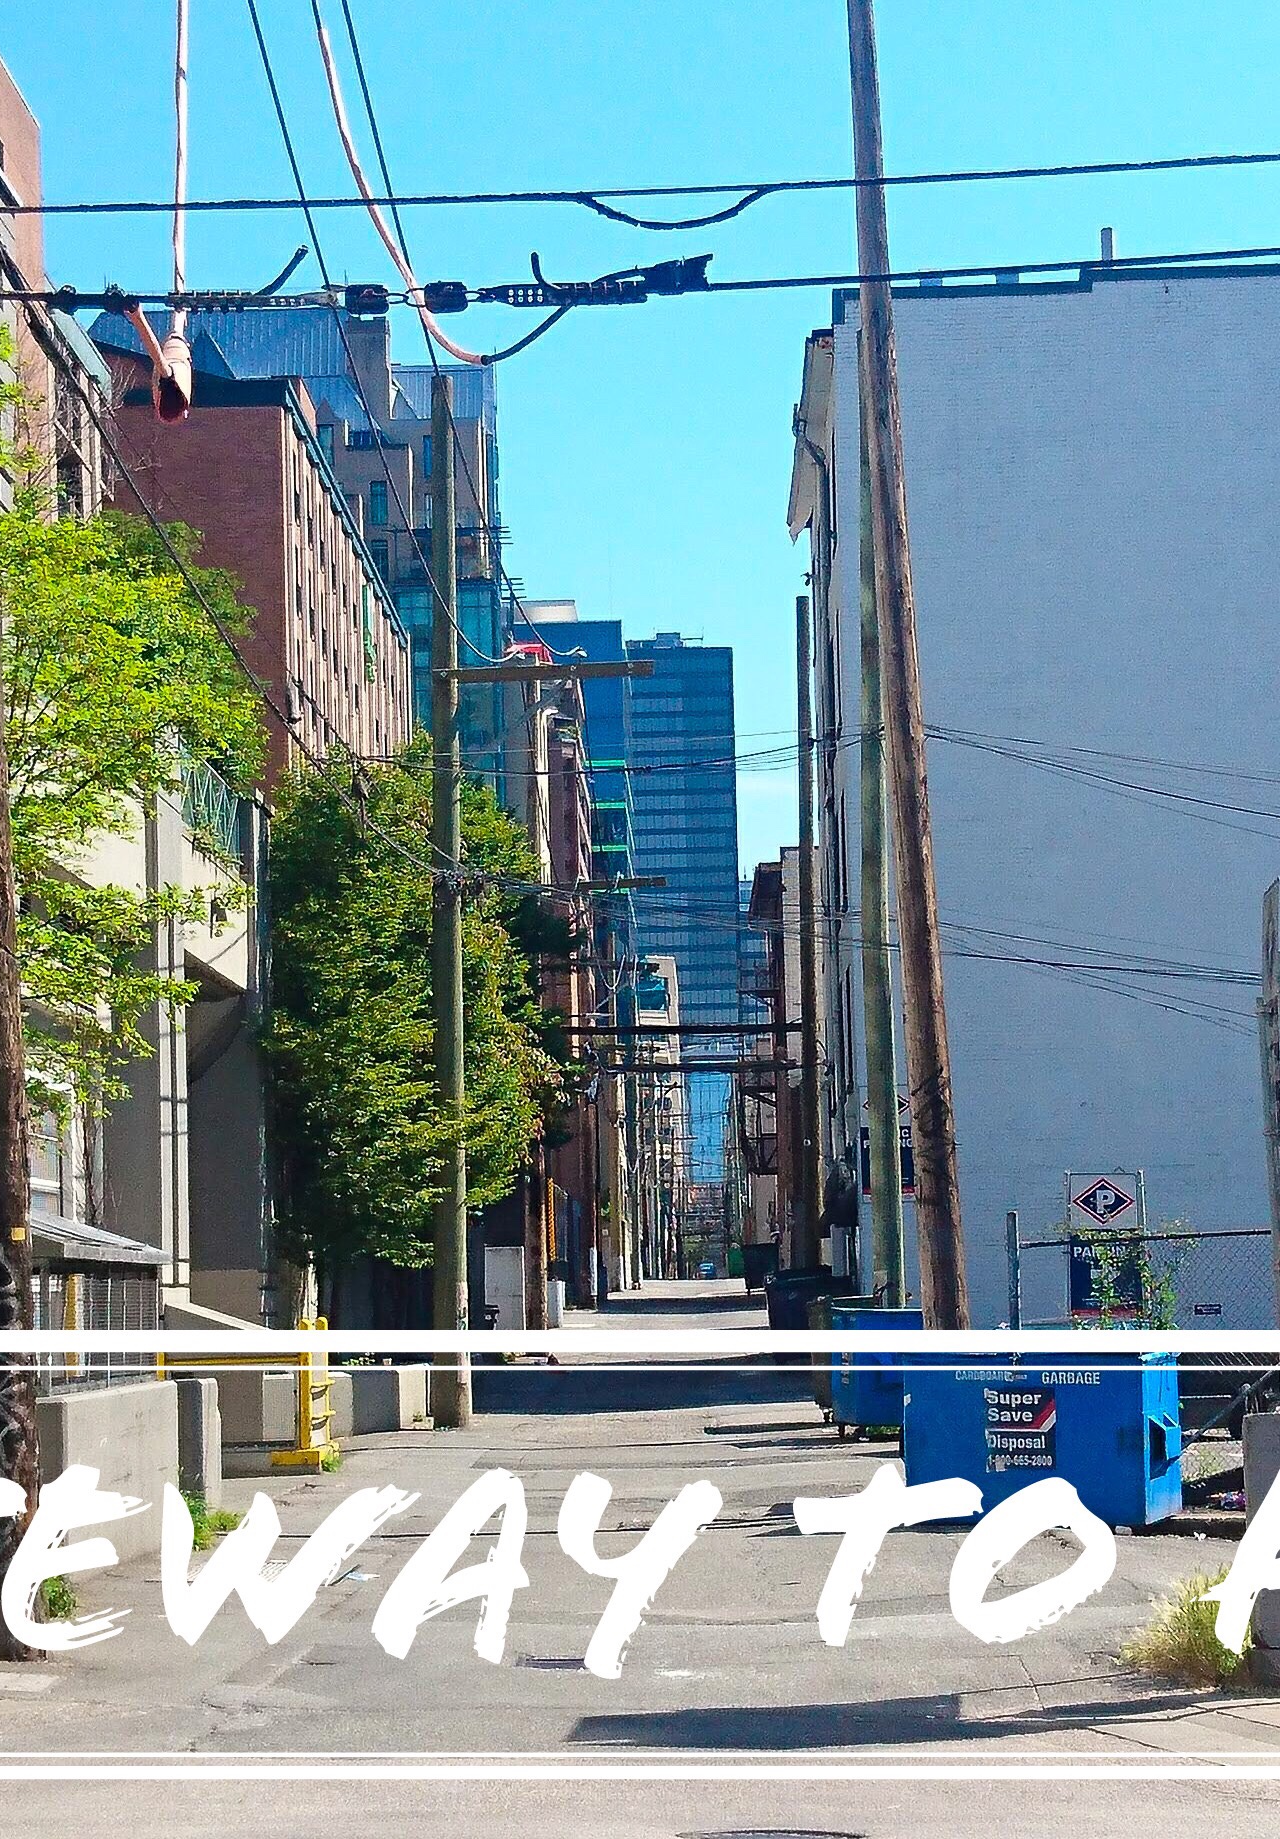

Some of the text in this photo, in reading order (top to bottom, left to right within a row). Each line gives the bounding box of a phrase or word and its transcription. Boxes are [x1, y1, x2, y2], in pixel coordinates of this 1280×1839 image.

[1041, 1371, 1101, 1385] GARBAGE
[986, 1390, 1042, 1408] Super
[987, 1408, 1034, 1422] Save
[987, 1434, 1046, 1452] Disposal
